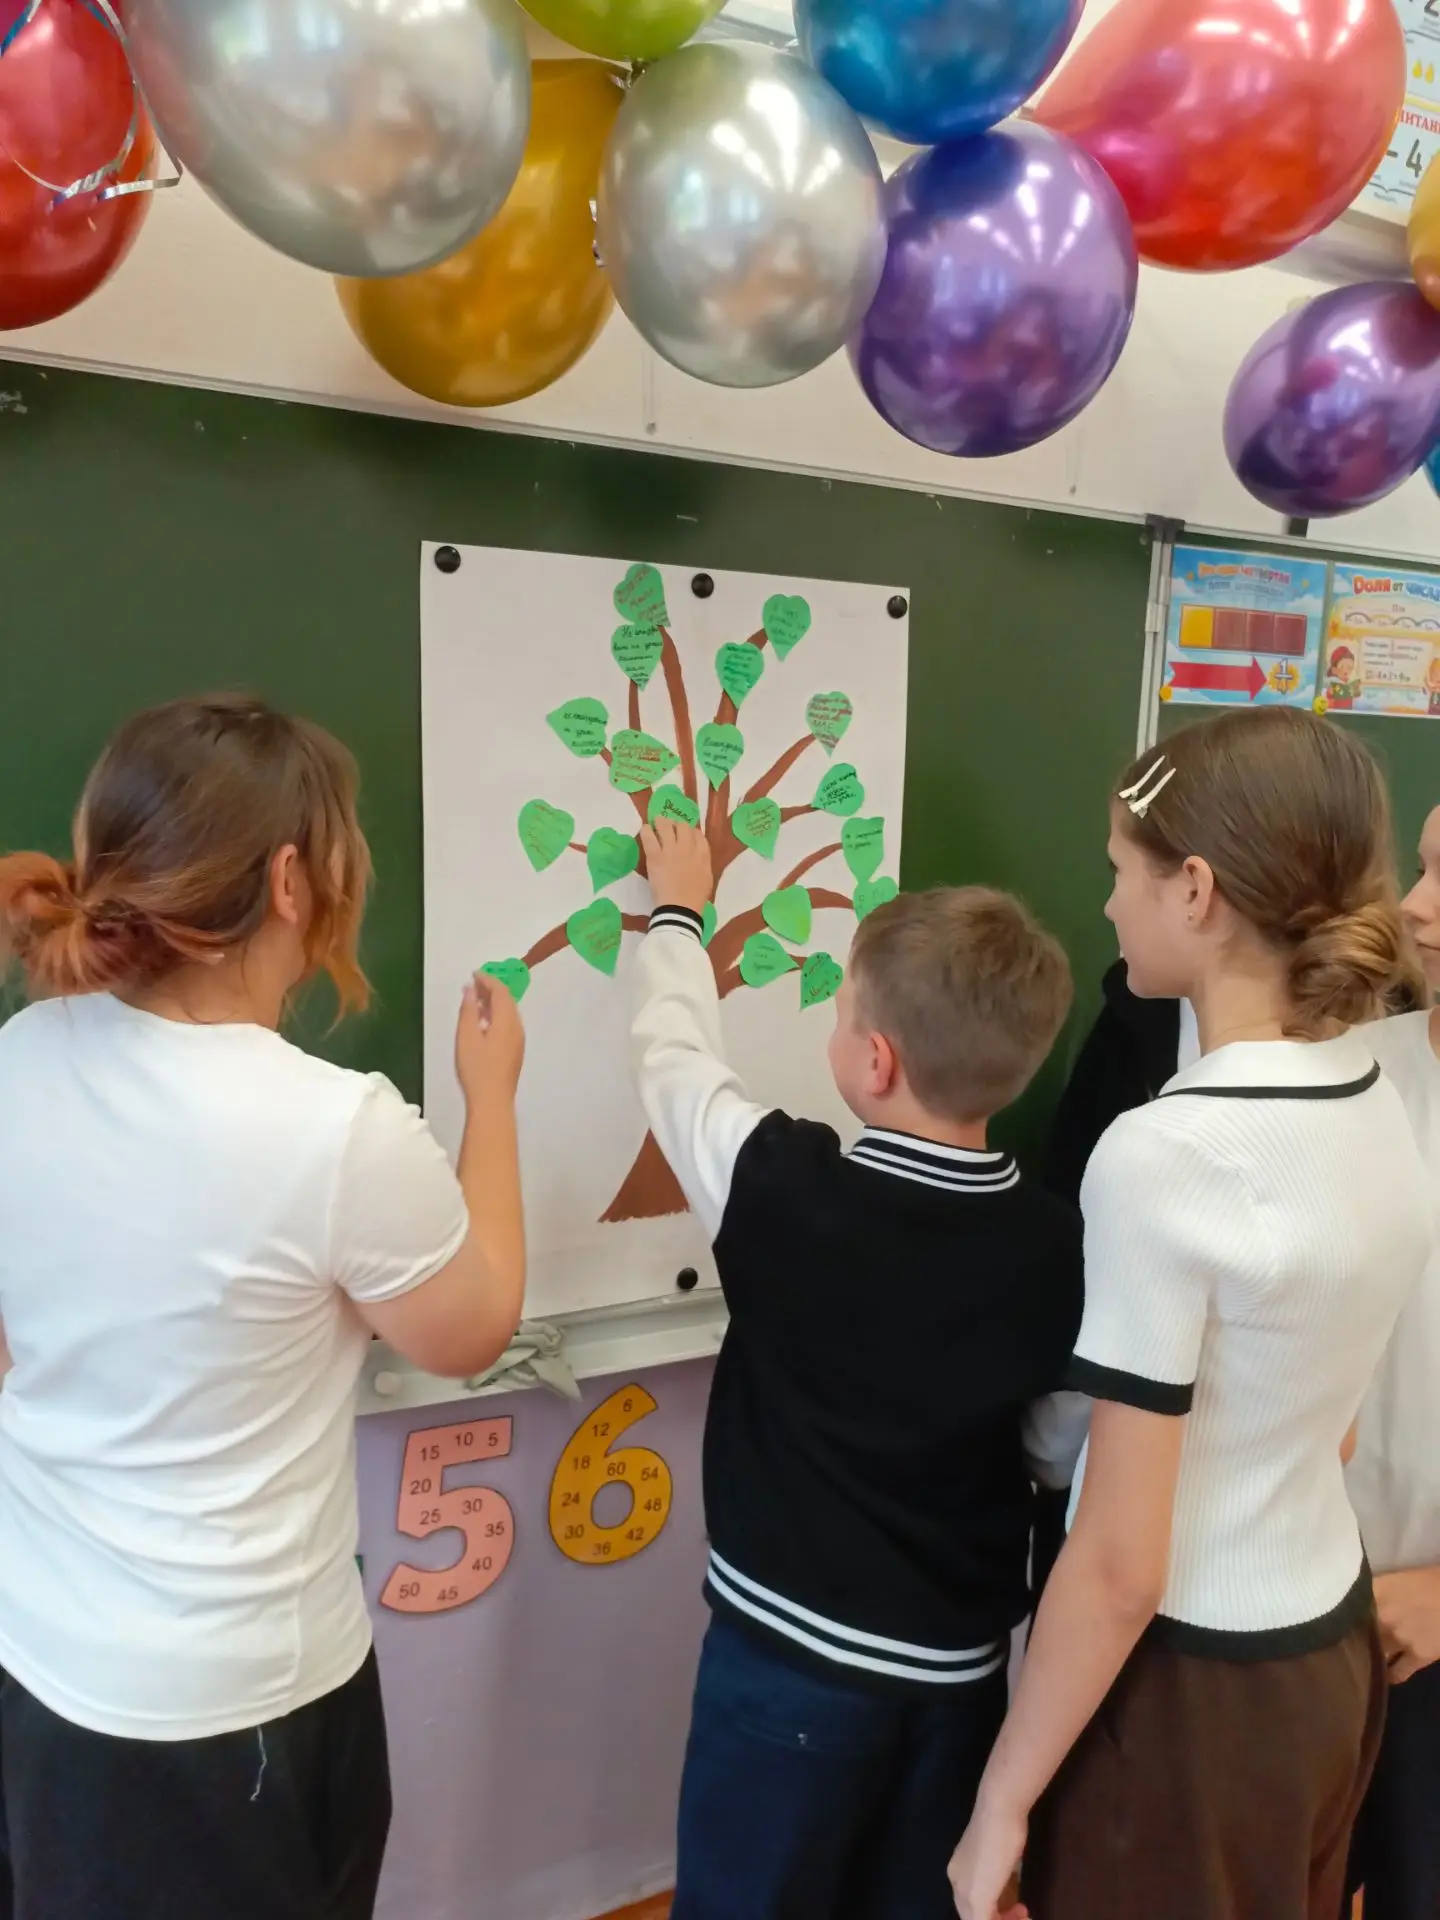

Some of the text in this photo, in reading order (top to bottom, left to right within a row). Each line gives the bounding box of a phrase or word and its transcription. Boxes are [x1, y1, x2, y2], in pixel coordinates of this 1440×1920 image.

[1405, 138, 1422, 178] 4
[622, 1398, 632, 1412] 6
[591, 1422, 610, 1437] 12
[455, 1432, 474, 1447] 10
[488, 1432, 499, 1447] 5
[420, 1444, 440, 1461] 15
[572, 1455, 591, 1470] 18
[606, 1461, 626, 1477] 60
[548, 1382, 673, 1566] 6
[640, 1466, 659, 1481] 54
[410, 1479, 432, 1495] 20
[462, 1498, 483, 1515] 30
[561, 1491, 580, 1507] 24
[643, 1498, 662, 1512] 48
[378, 1414, 516, 1614] 5
[419, 1508, 441, 1526] 25
[484, 1521, 505, 1538] 35
[564, 1524, 584, 1540] 30
[625, 1527, 645, 1541] 42
[593, 1541, 611, 1556] 36
[471, 1556, 492, 1571] 40
[399, 1582, 420, 1599] 50
[436, 1586, 459, 1602] 45
